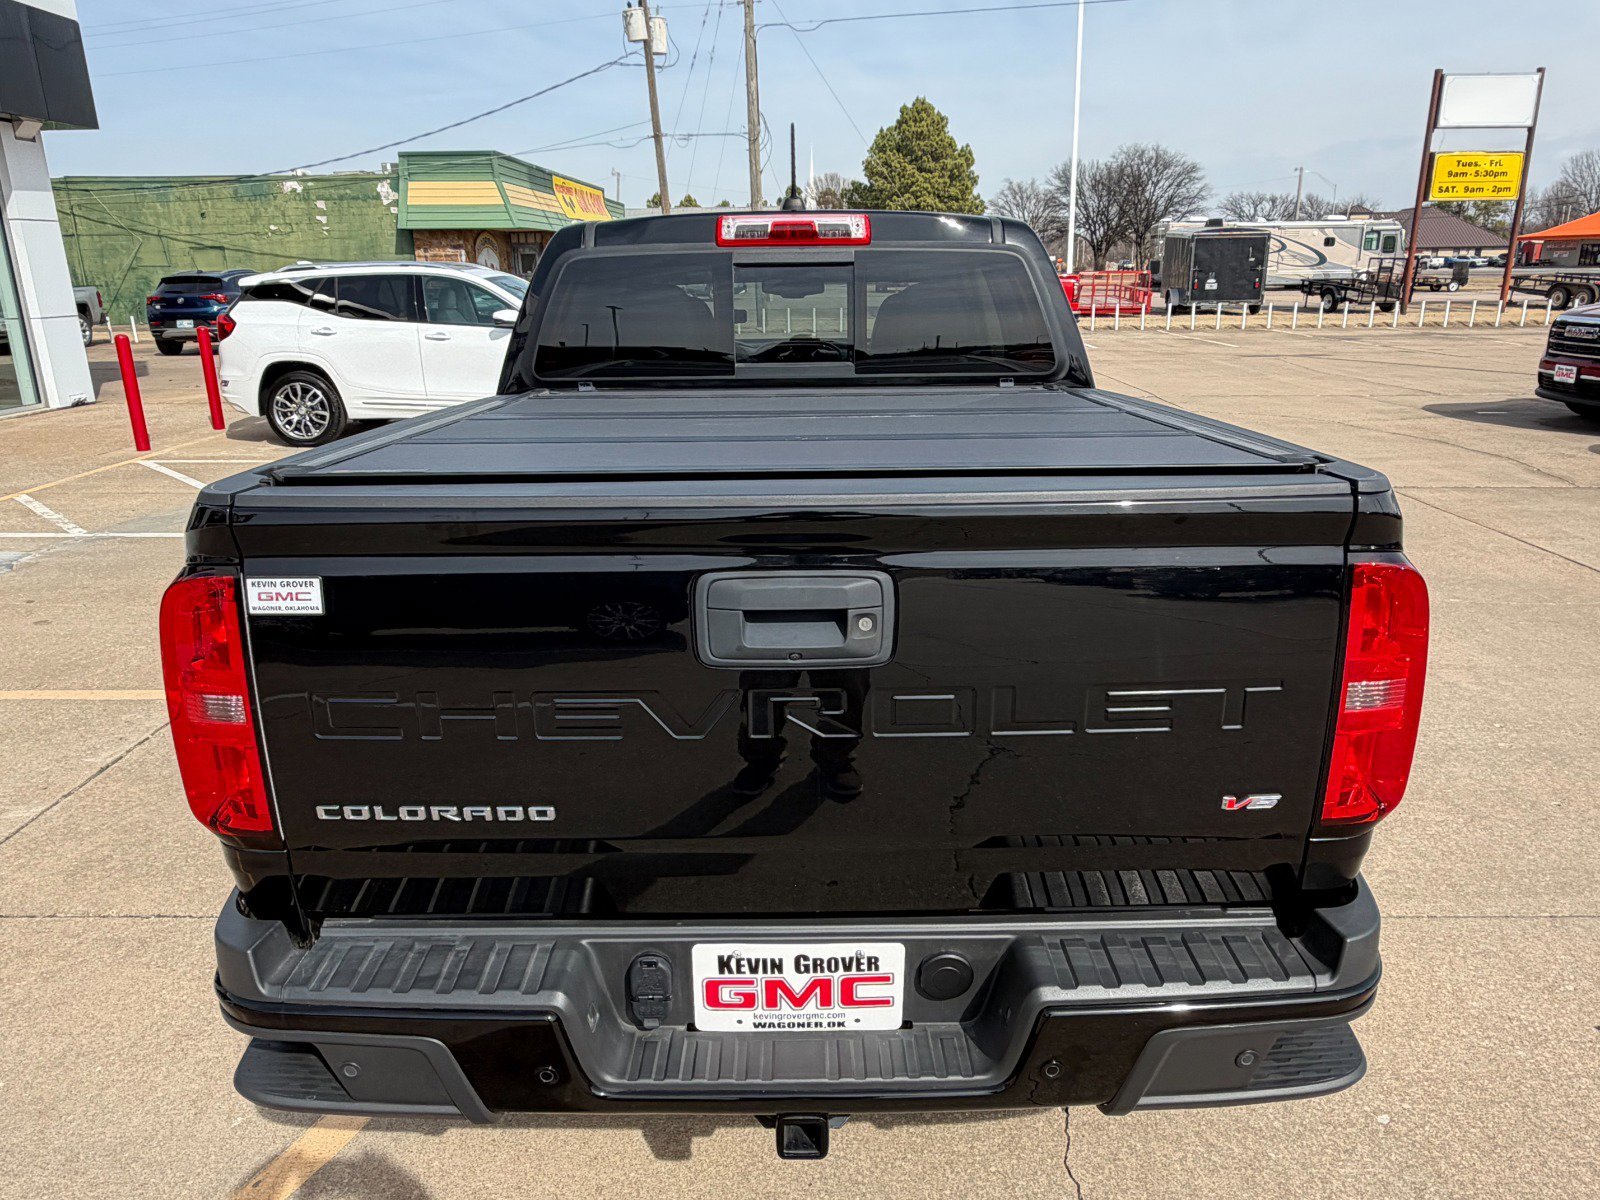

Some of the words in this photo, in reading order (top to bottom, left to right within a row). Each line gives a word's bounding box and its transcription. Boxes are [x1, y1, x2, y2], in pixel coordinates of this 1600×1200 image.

[1447, 170, 1468, 178] 9am
[1474, 170, 1508, 179] 5:30pm
[1438, 186, 1459, 194] SAT.
[1491, 186, 1511, 194] 2pm
[1555, 370, 1575, 379] GMC
[251, 580, 277, 588] KEVIN
[280, 580, 315, 588] GROVER
[257, 591, 312, 602] GMC
[311, 681, 1283, 741] CHEVROLET
[1221, 793, 1282, 811] V6
[315, 805, 556, 822] COLORADO
[717, 954, 784, 975] KEVIN
[794, 954, 880, 974] GROVER
[702, 973, 894, 1012] GMC
[753, 1012, 846, 1020] kevingrovergmc.com
